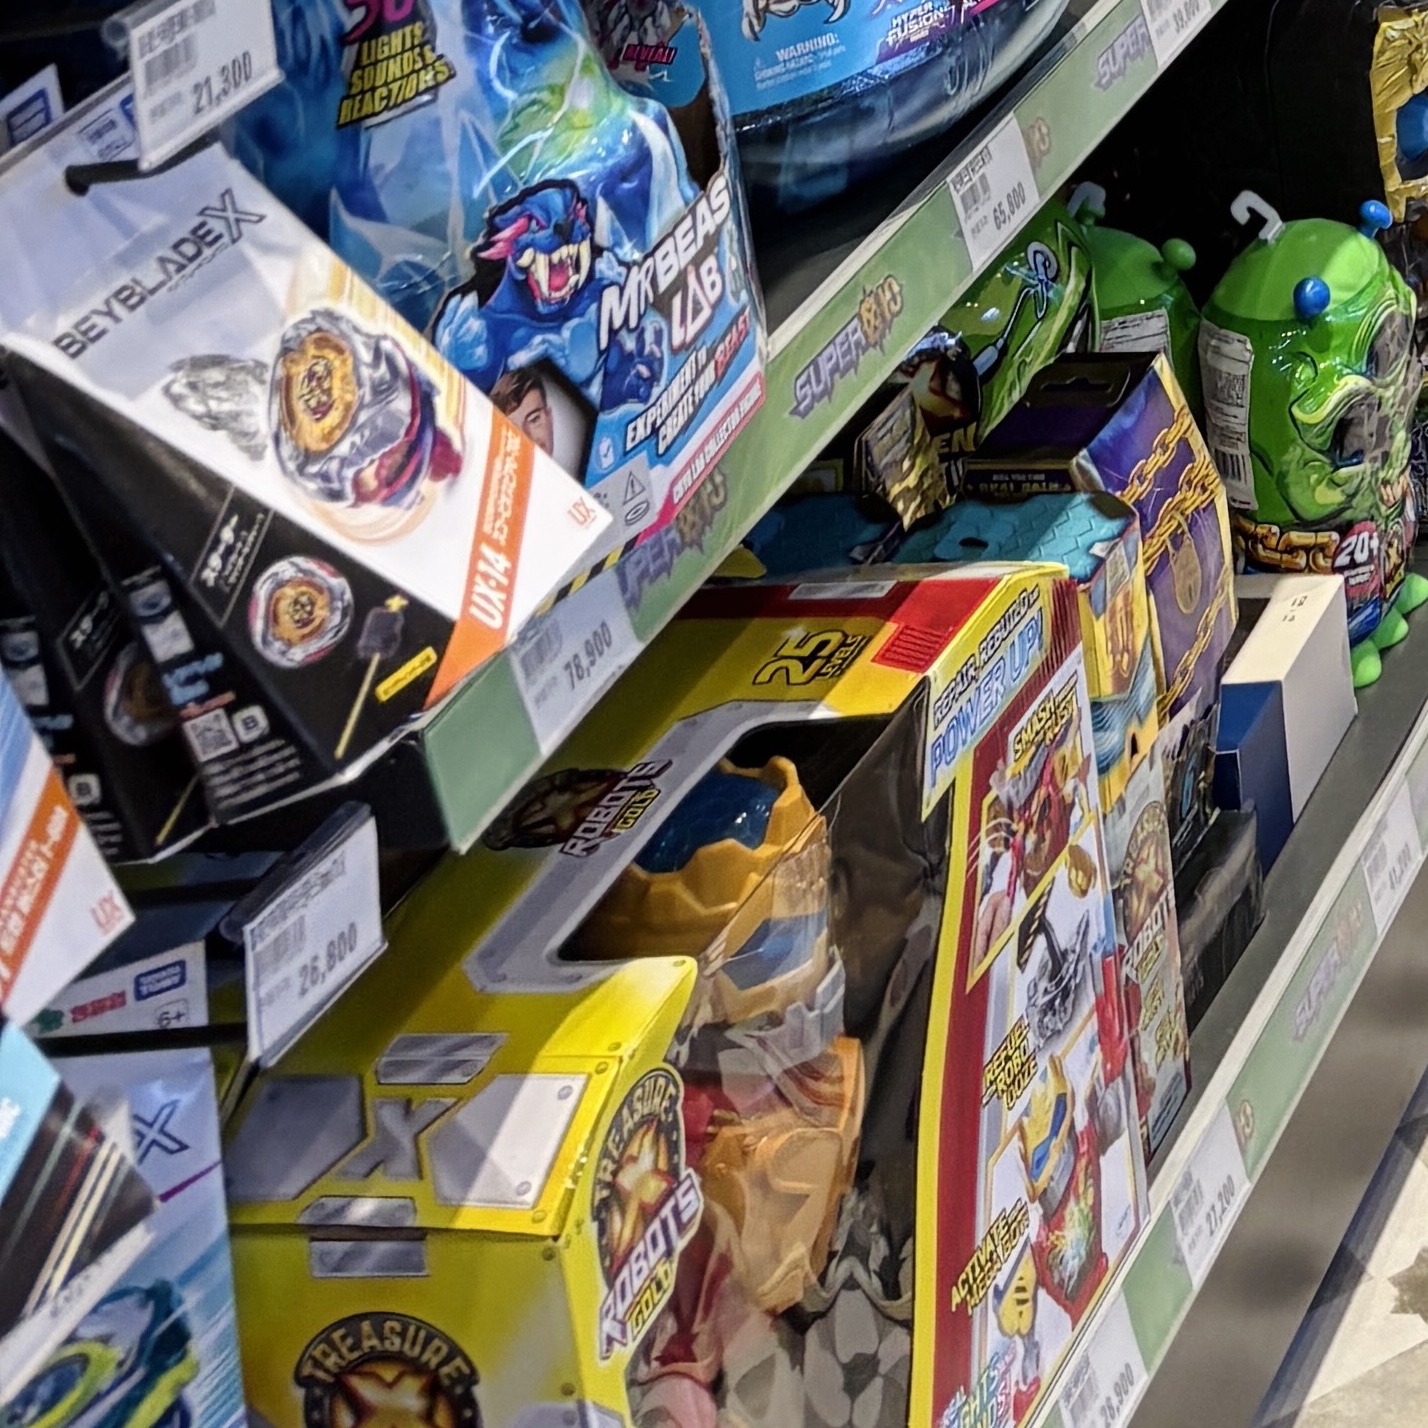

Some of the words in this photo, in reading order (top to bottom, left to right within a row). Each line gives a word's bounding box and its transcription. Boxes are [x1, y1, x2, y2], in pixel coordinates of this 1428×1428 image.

[191, 49, 254, 117] 21,300
[350, 50, 421, 90] SOUNDS
[668, 260, 726, 345] LAB
[561, 620, 614, 695] 78,900
[752, 628, 845, 687] 25
[929, 656, 1007, 790] POWER
[1009, 606, 1044, 684] UP!
[1012, 689, 1055, 764] SMASH
[560, 758, 675, 861] ROBOTS
[615, 786, 662, 836] GOLD
[983, 1017, 1030, 1089] REFUEL
[996, 1044, 1031, 1093] ROBO
[599, 1177, 703, 1360] ROBOTS
[950, 1206, 1009, 1312] ACTIVATE
[631, 1264, 674, 1341] GOLD
[303, 1315, 471, 1388] TREASURE
